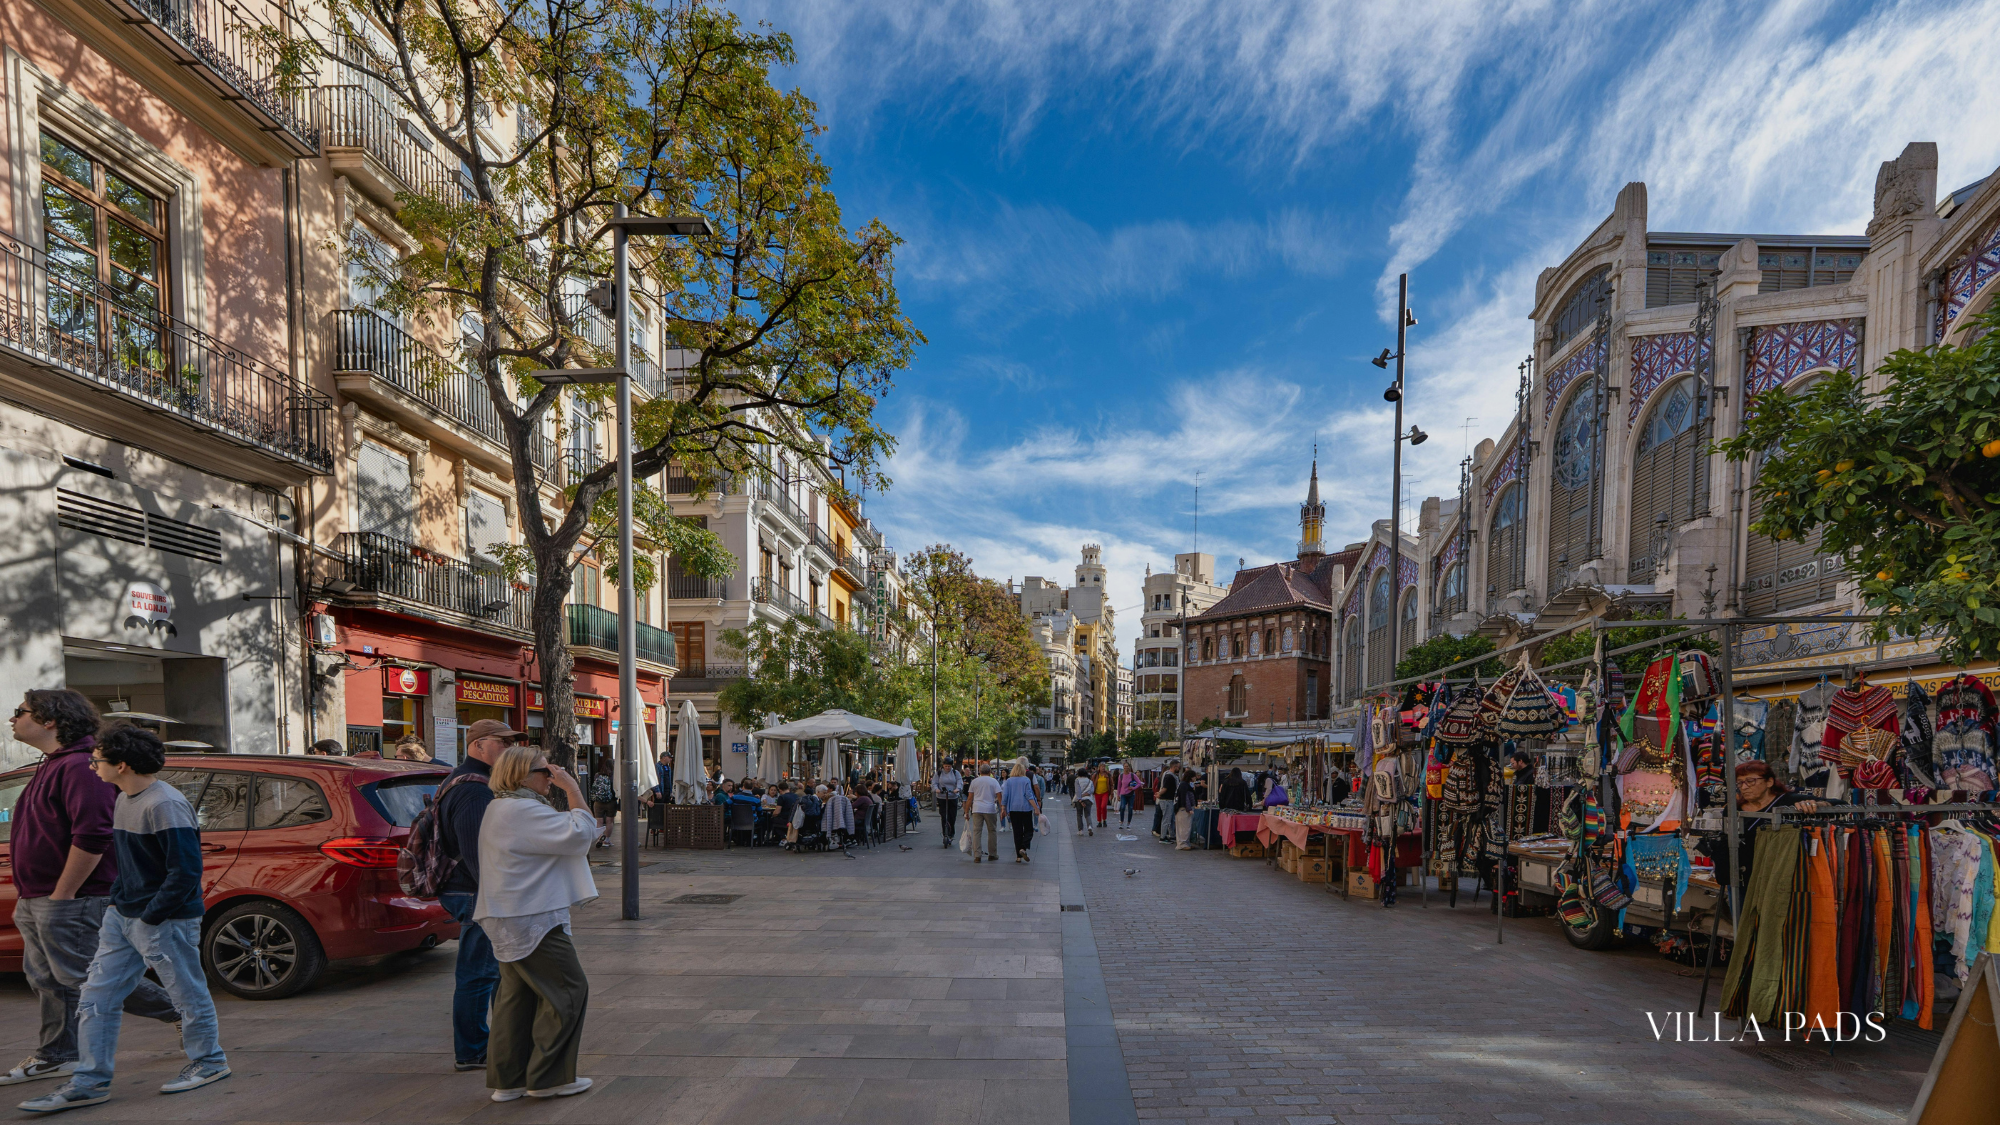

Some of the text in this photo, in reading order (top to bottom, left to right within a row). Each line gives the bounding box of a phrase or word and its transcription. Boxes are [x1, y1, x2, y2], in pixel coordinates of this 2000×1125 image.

[131, 590, 167, 603] SOUVENIRS
[132, 600, 168, 613] LA LONJA
[877, 571, 885, 641] FARMACIA
[463, 680, 509, 694] CALAMARES
[463, 689, 510, 703] PESCADITOS
